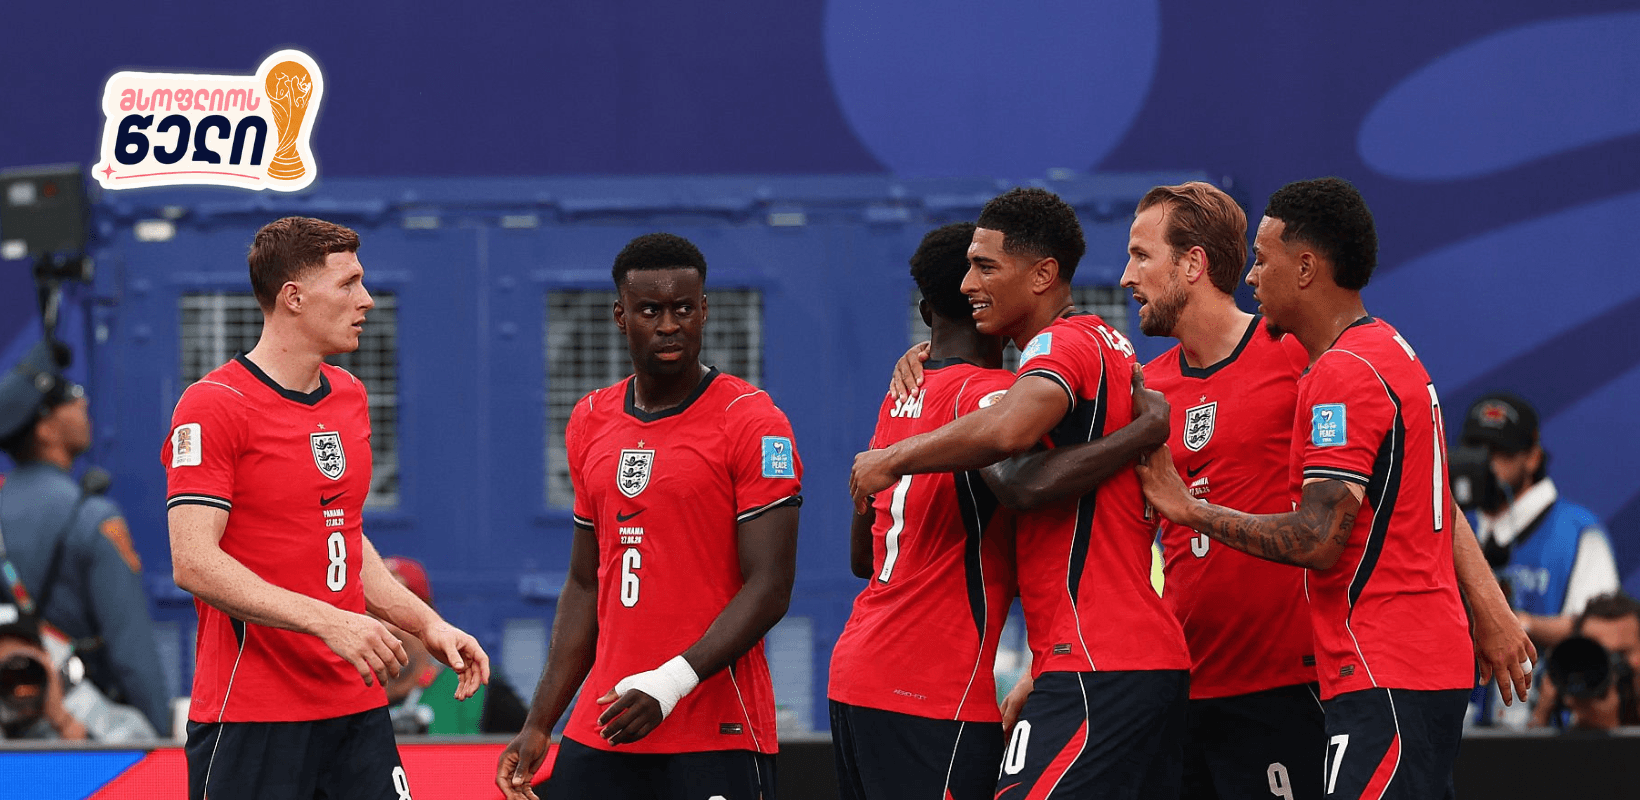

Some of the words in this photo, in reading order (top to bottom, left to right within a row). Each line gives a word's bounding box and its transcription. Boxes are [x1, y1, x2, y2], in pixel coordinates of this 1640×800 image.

[323, 508, 345, 517] PANAMA
[619, 527, 644, 535] PANAMA
[326, 531, 347, 592] 8
[620, 547, 642, 608] 6
